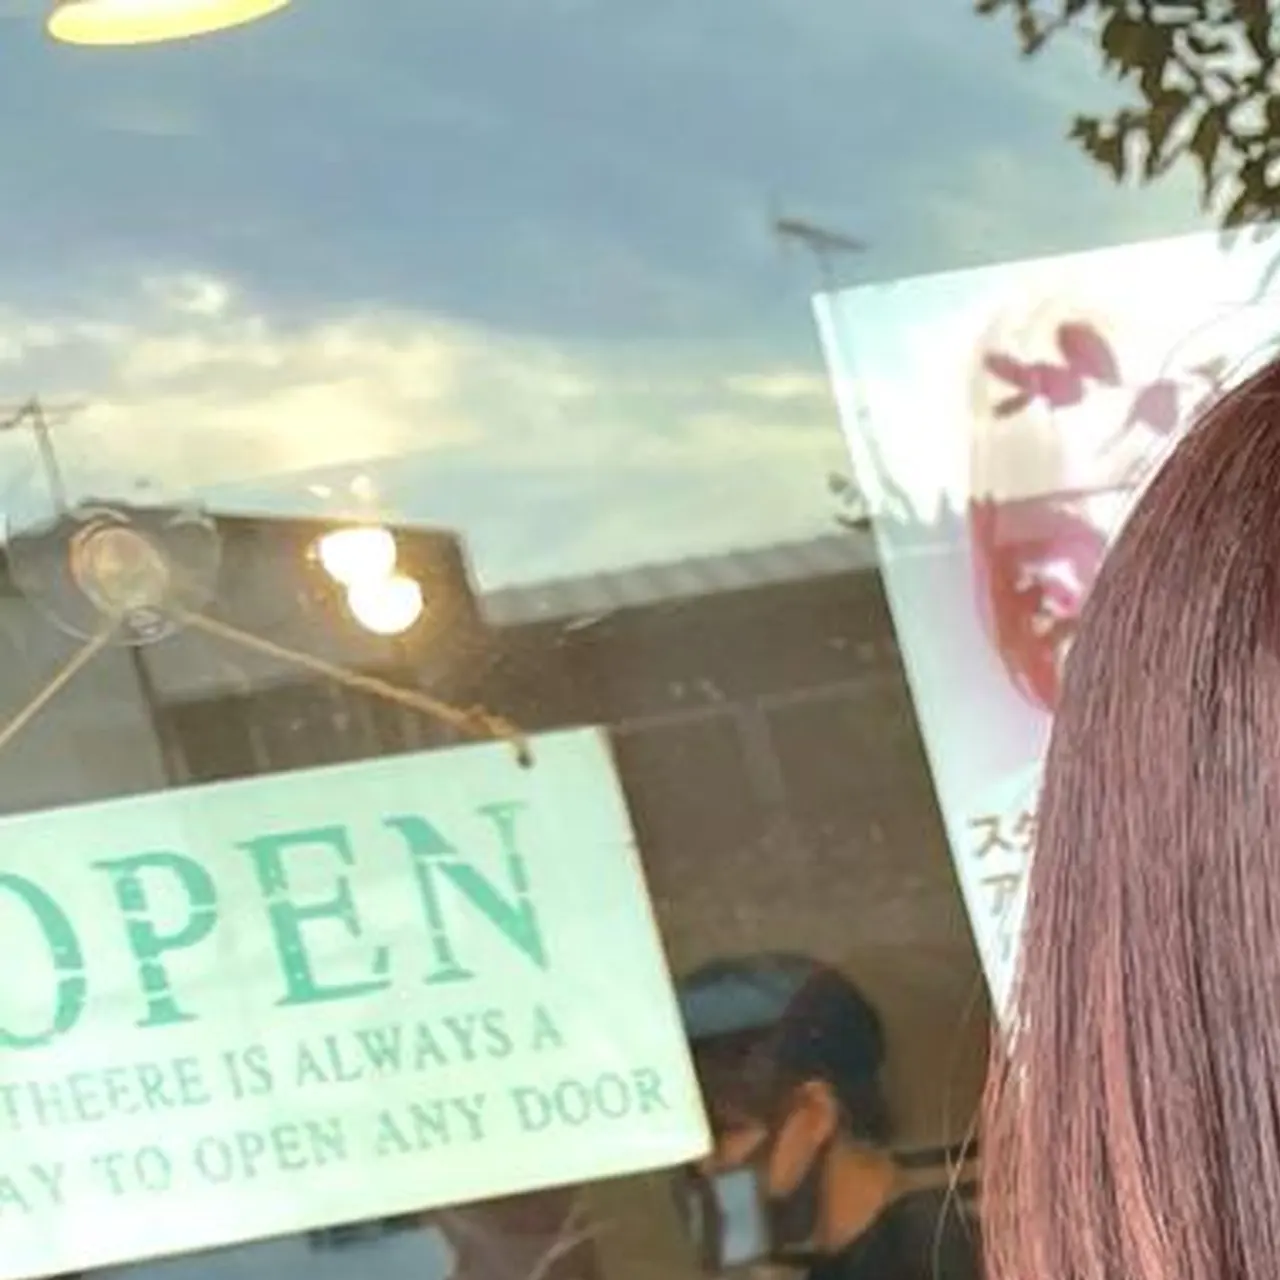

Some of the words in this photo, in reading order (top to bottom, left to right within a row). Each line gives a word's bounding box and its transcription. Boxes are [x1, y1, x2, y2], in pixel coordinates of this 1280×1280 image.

[0, 801, 550, 1049] OPEN
[221, 1044, 273, 1100] IS
[295, 1008, 514, 1087] ALWAYS
[531, 1003, 565, 1051] A
[90, 1145, 172, 1196] TO
[194, 1116, 347, 1184] OPEN
[376, 1093, 486, 1155] ANY
[511, 1067, 670, 1132] DOOR
